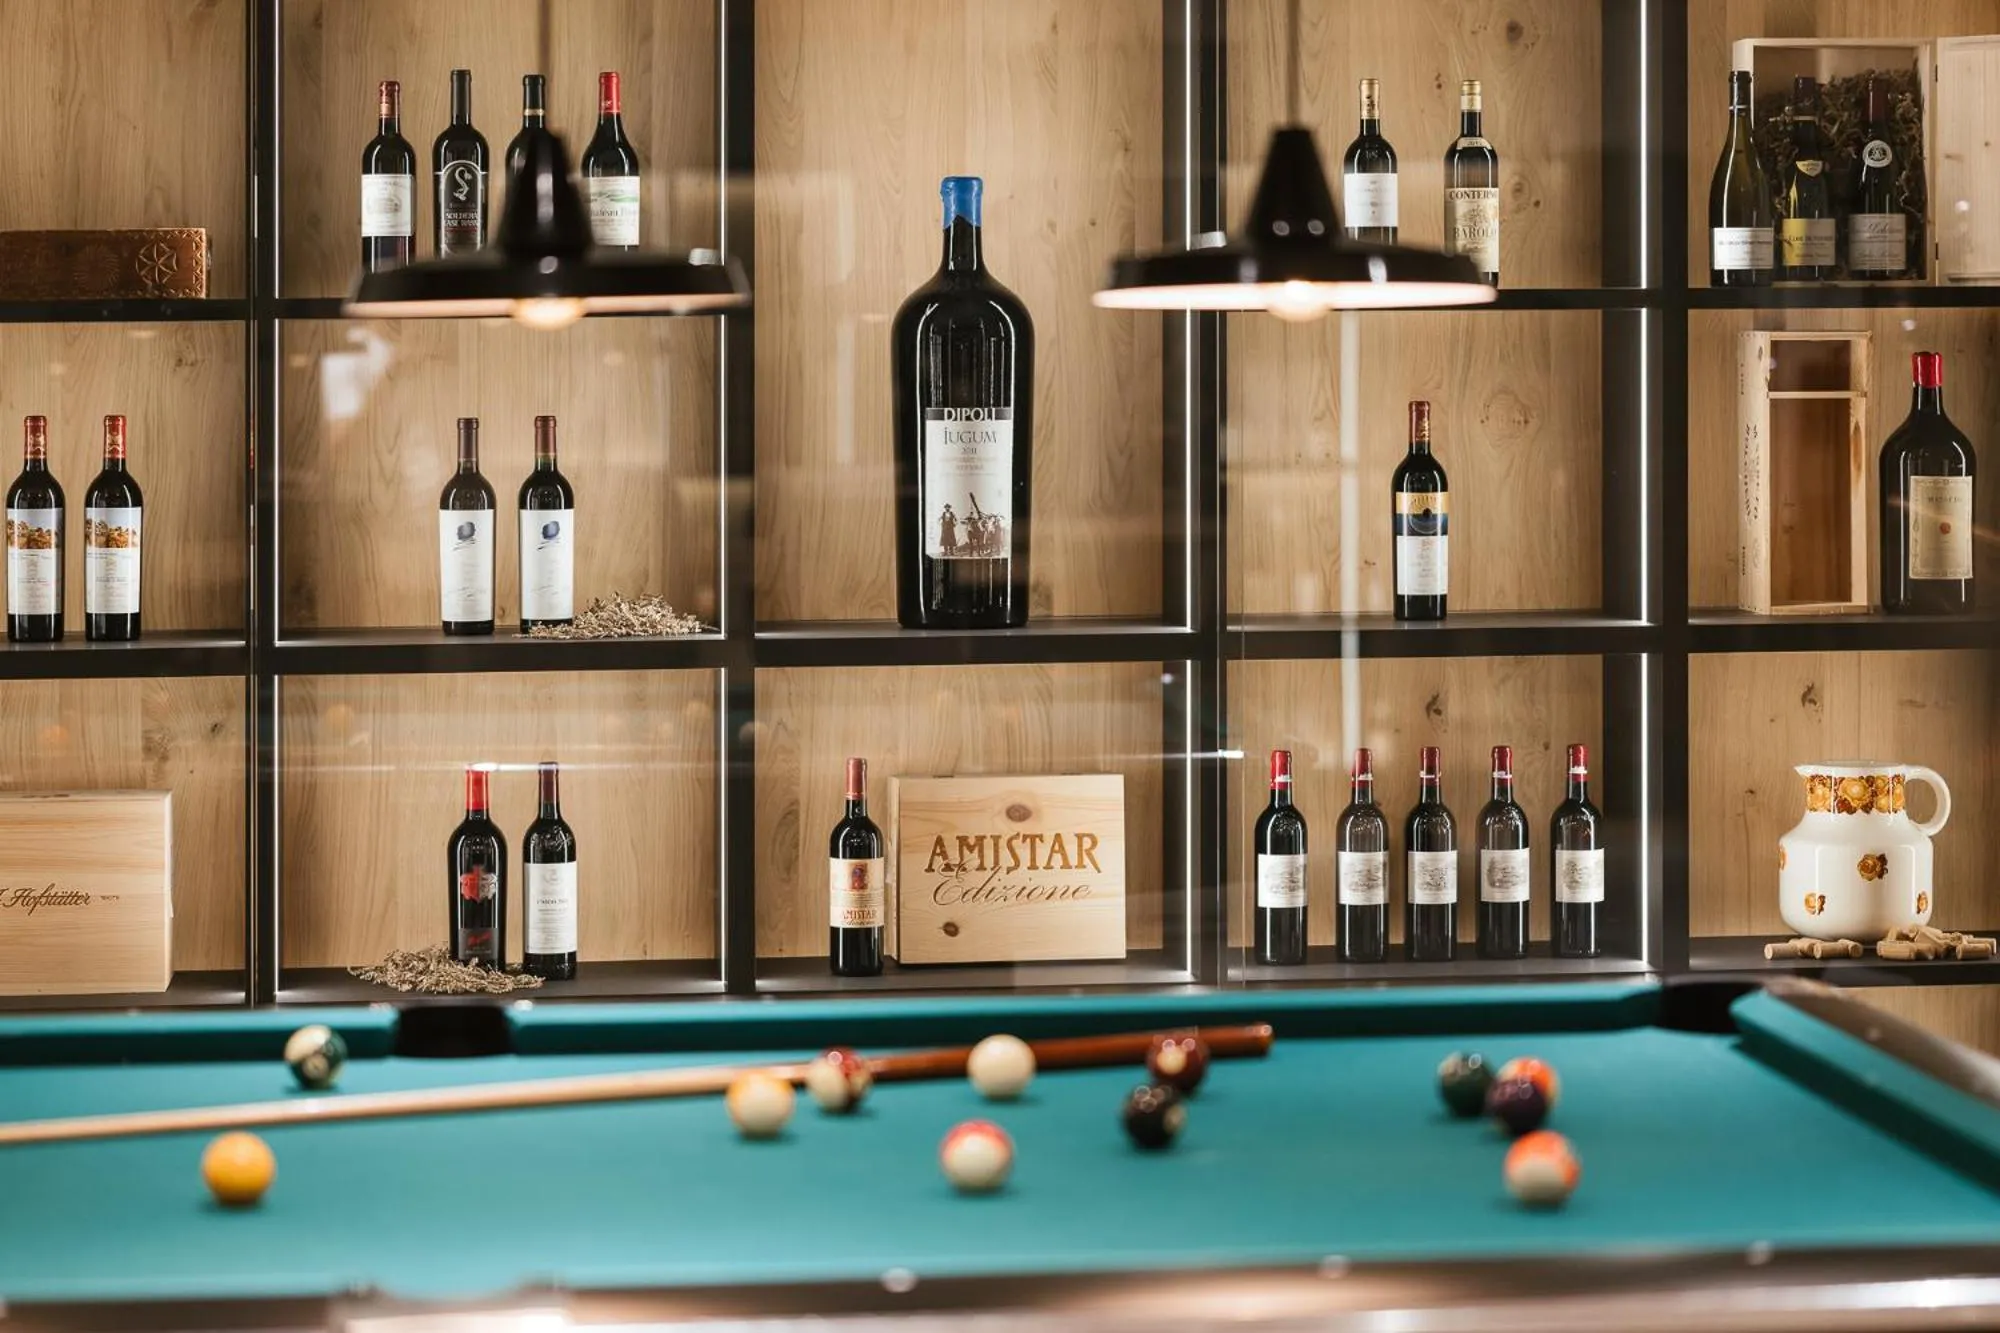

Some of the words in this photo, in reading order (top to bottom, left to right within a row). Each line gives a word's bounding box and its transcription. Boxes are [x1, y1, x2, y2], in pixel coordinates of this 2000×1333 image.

[943, 407, 996, 422] DIPOLI
[924, 832, 1102, 875] AMISTAR
[2, 882, 91, 917] Hofstätter
[932, 859, 1092, 906] Edizione
